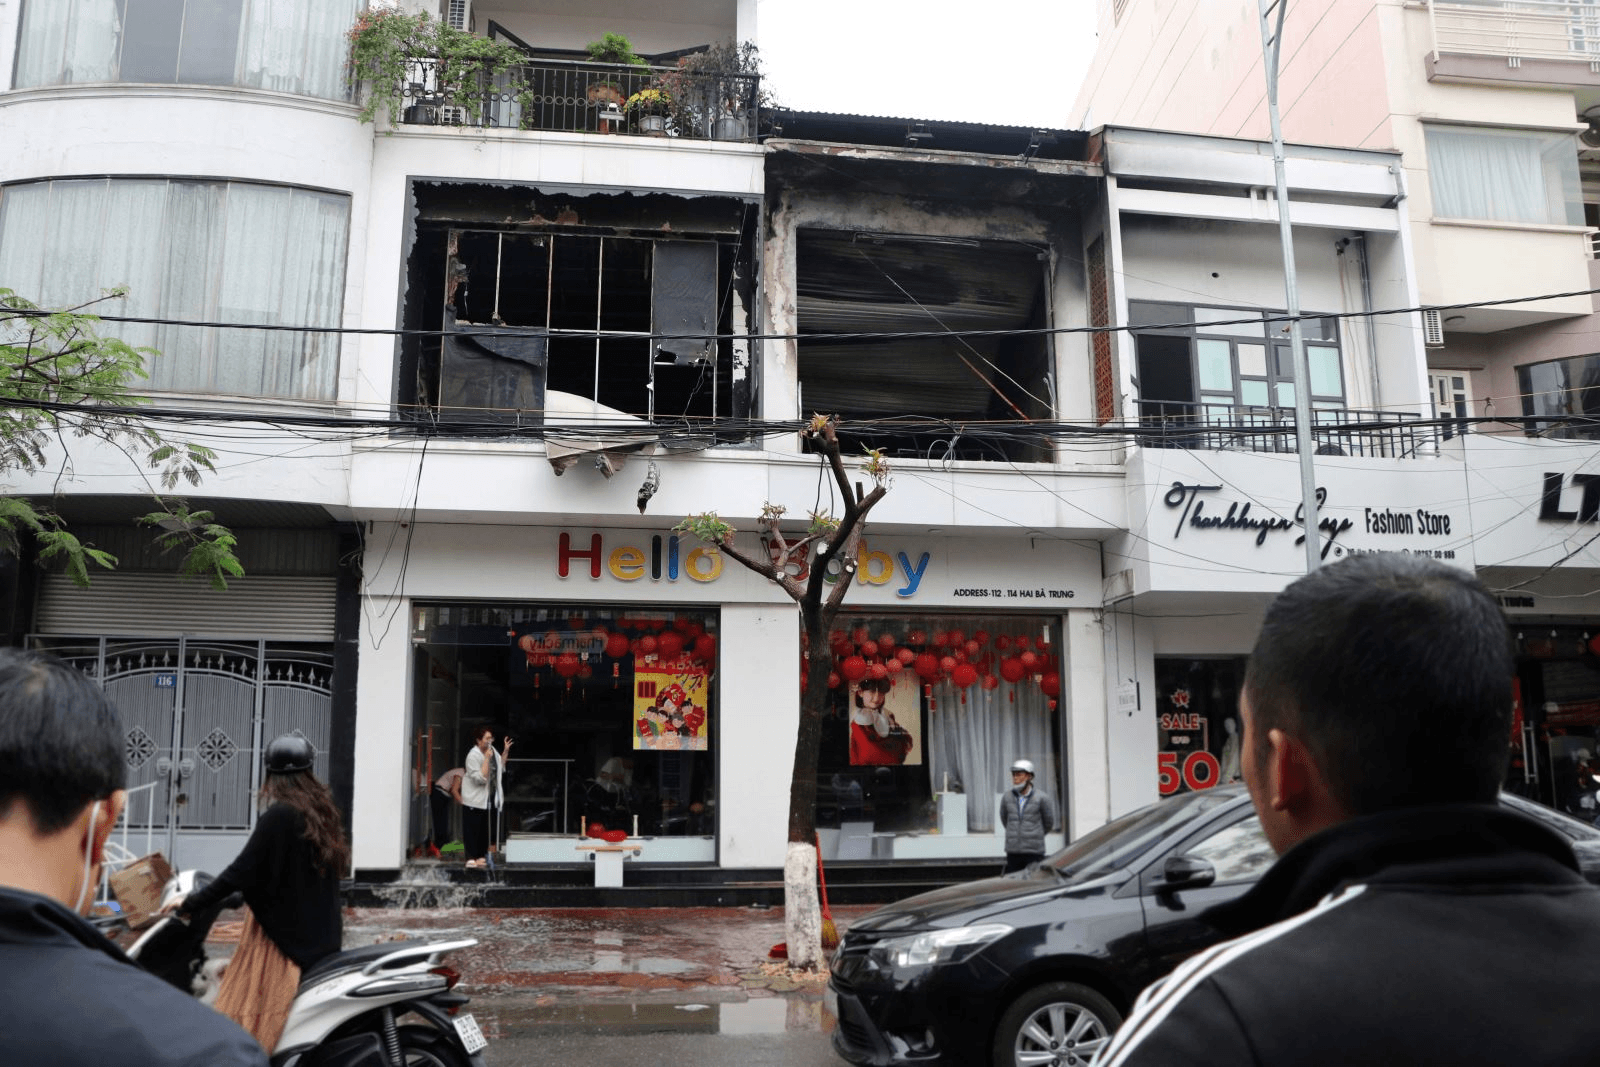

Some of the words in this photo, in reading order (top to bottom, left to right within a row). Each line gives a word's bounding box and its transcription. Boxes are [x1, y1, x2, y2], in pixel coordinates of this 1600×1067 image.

[1364, 507, 1414, 535] Fashion
[1416, 508, 1451, 536] Store
[557, 532, 725, 582] Hello
[1019, 590, 1034, 598] HAI
[158, 676, 172, 686] 116
[1160, 713, 1201, 731] SALE
[1157, 750, 1221, 795] 50
